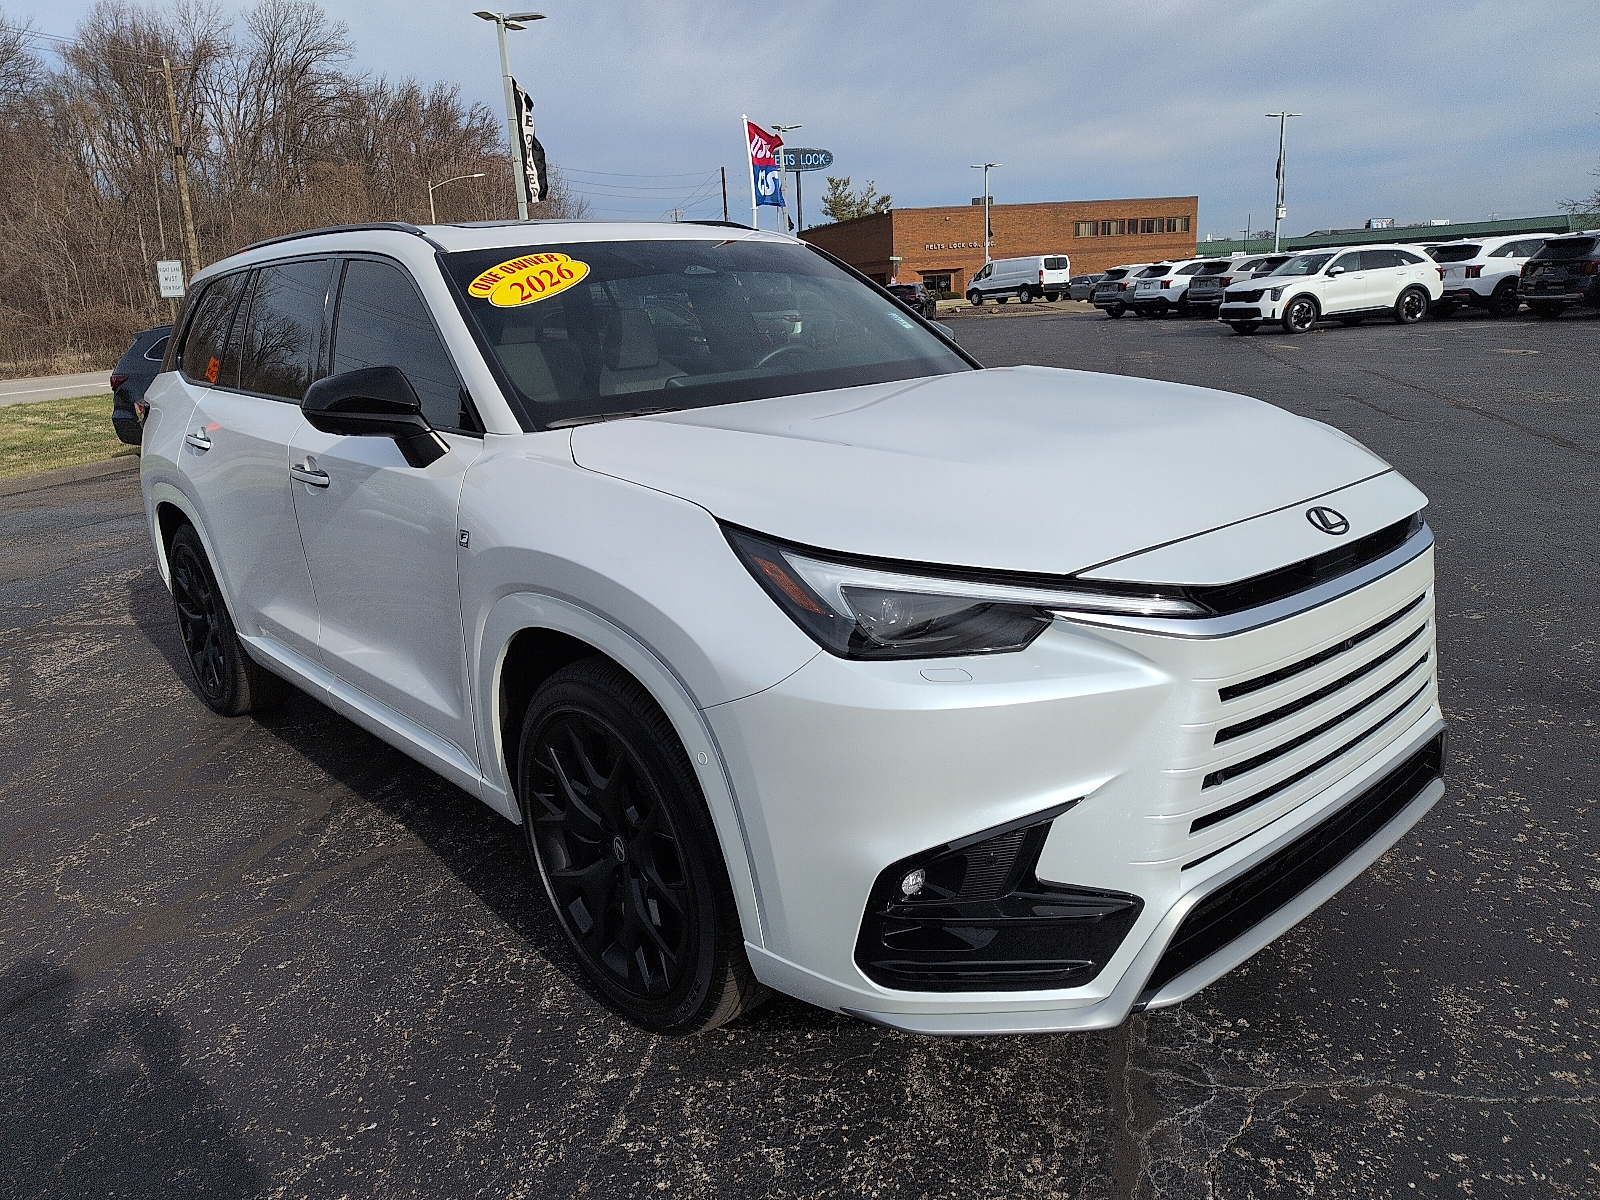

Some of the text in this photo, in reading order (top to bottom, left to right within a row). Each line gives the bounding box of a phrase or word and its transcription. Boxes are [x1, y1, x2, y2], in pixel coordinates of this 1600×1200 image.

[800, 153, 826, 165] LOCK
[472, 253, 560, 291] ONE OWNER
[509, 262, 574, 302] 2026
